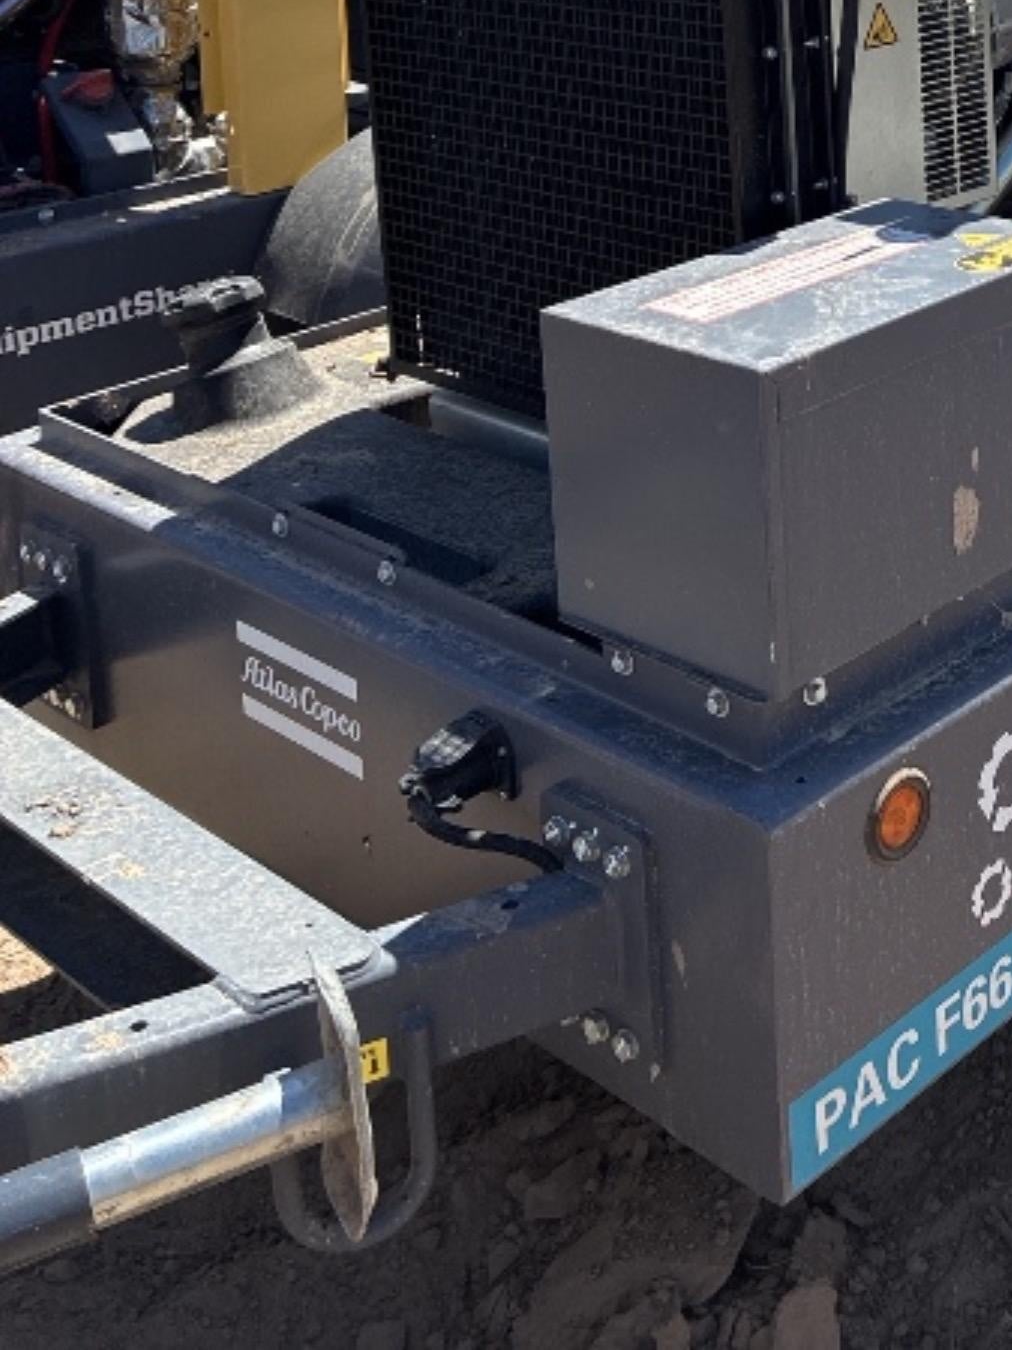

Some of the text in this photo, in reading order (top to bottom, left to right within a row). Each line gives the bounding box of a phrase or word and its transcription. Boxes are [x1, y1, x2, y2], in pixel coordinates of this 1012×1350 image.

[240, 656, 361, 741] Atlas Copco
[815, 1028, 921, 1156] PAC
